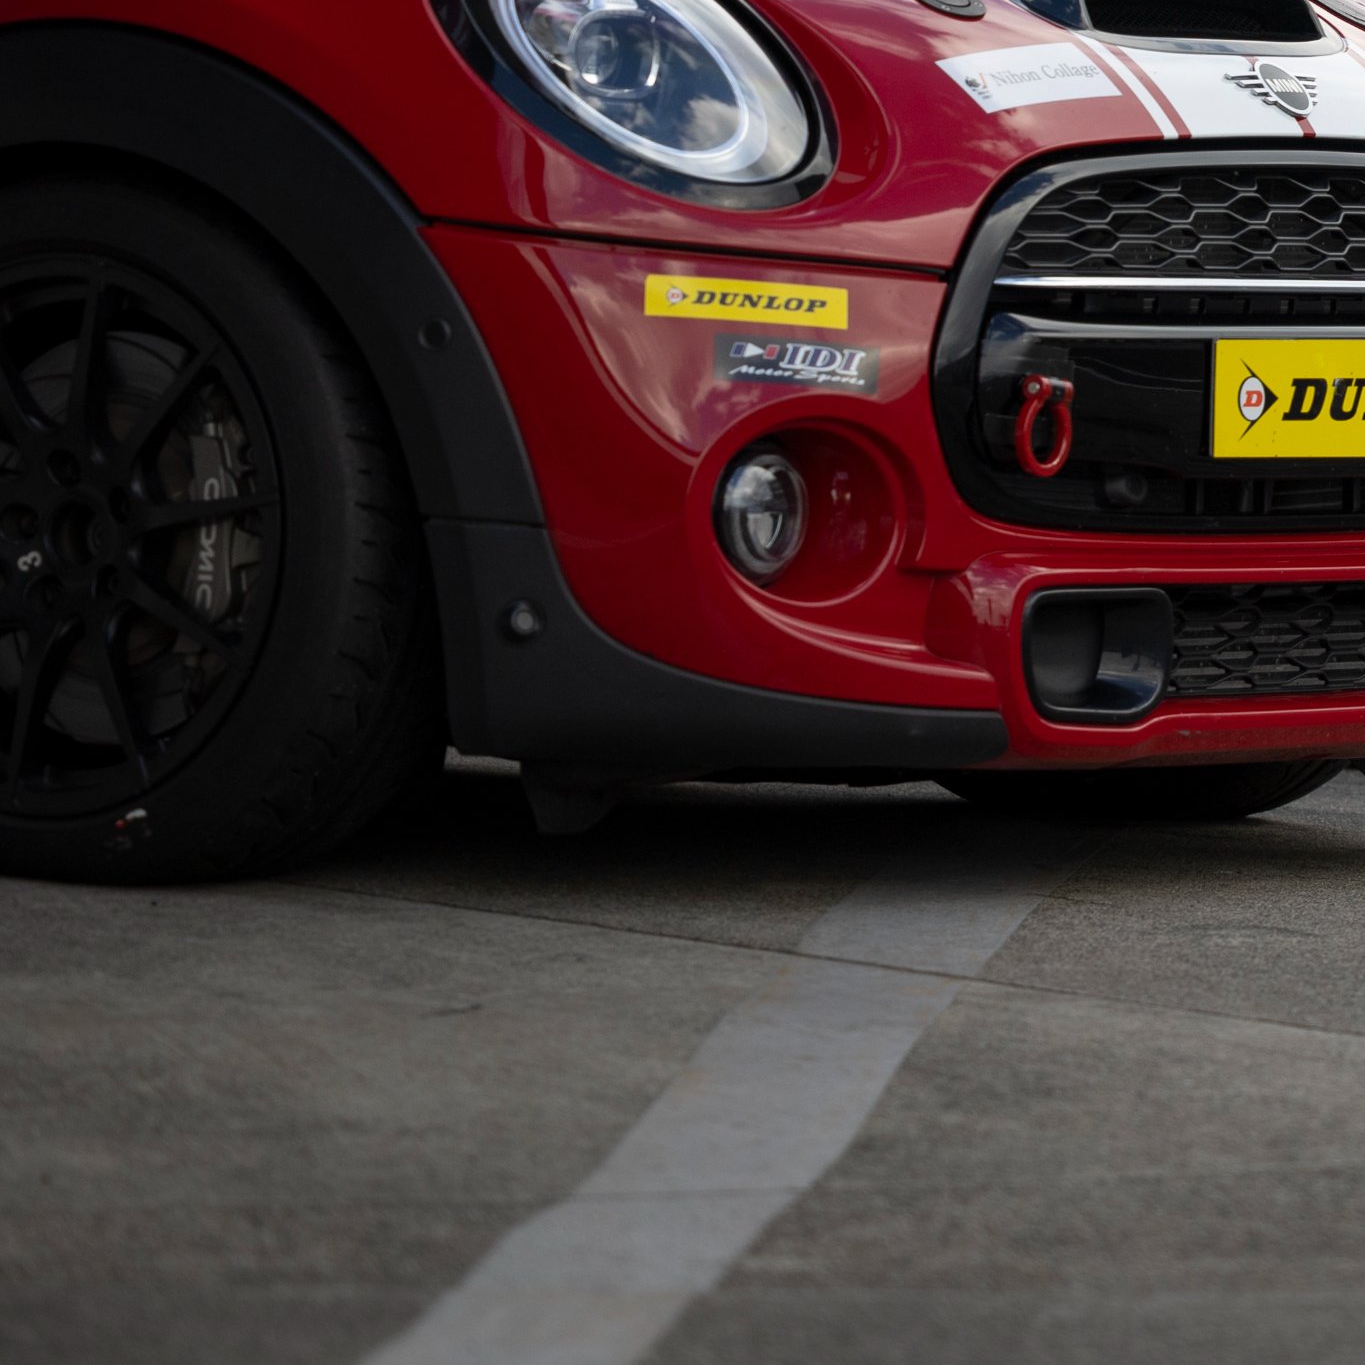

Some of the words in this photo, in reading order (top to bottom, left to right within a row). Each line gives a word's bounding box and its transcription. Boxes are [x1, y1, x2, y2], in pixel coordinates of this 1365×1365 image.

[989, 68, 1041, 87] Nihon
[1265, 78, 1304, 93] MINI
[693, 290, 827, 313] DUNLOP
[779, 342, 866, 375] IDI
[728, 364, 791, 377] Motor
[793, 369, 866, 385] Sports
